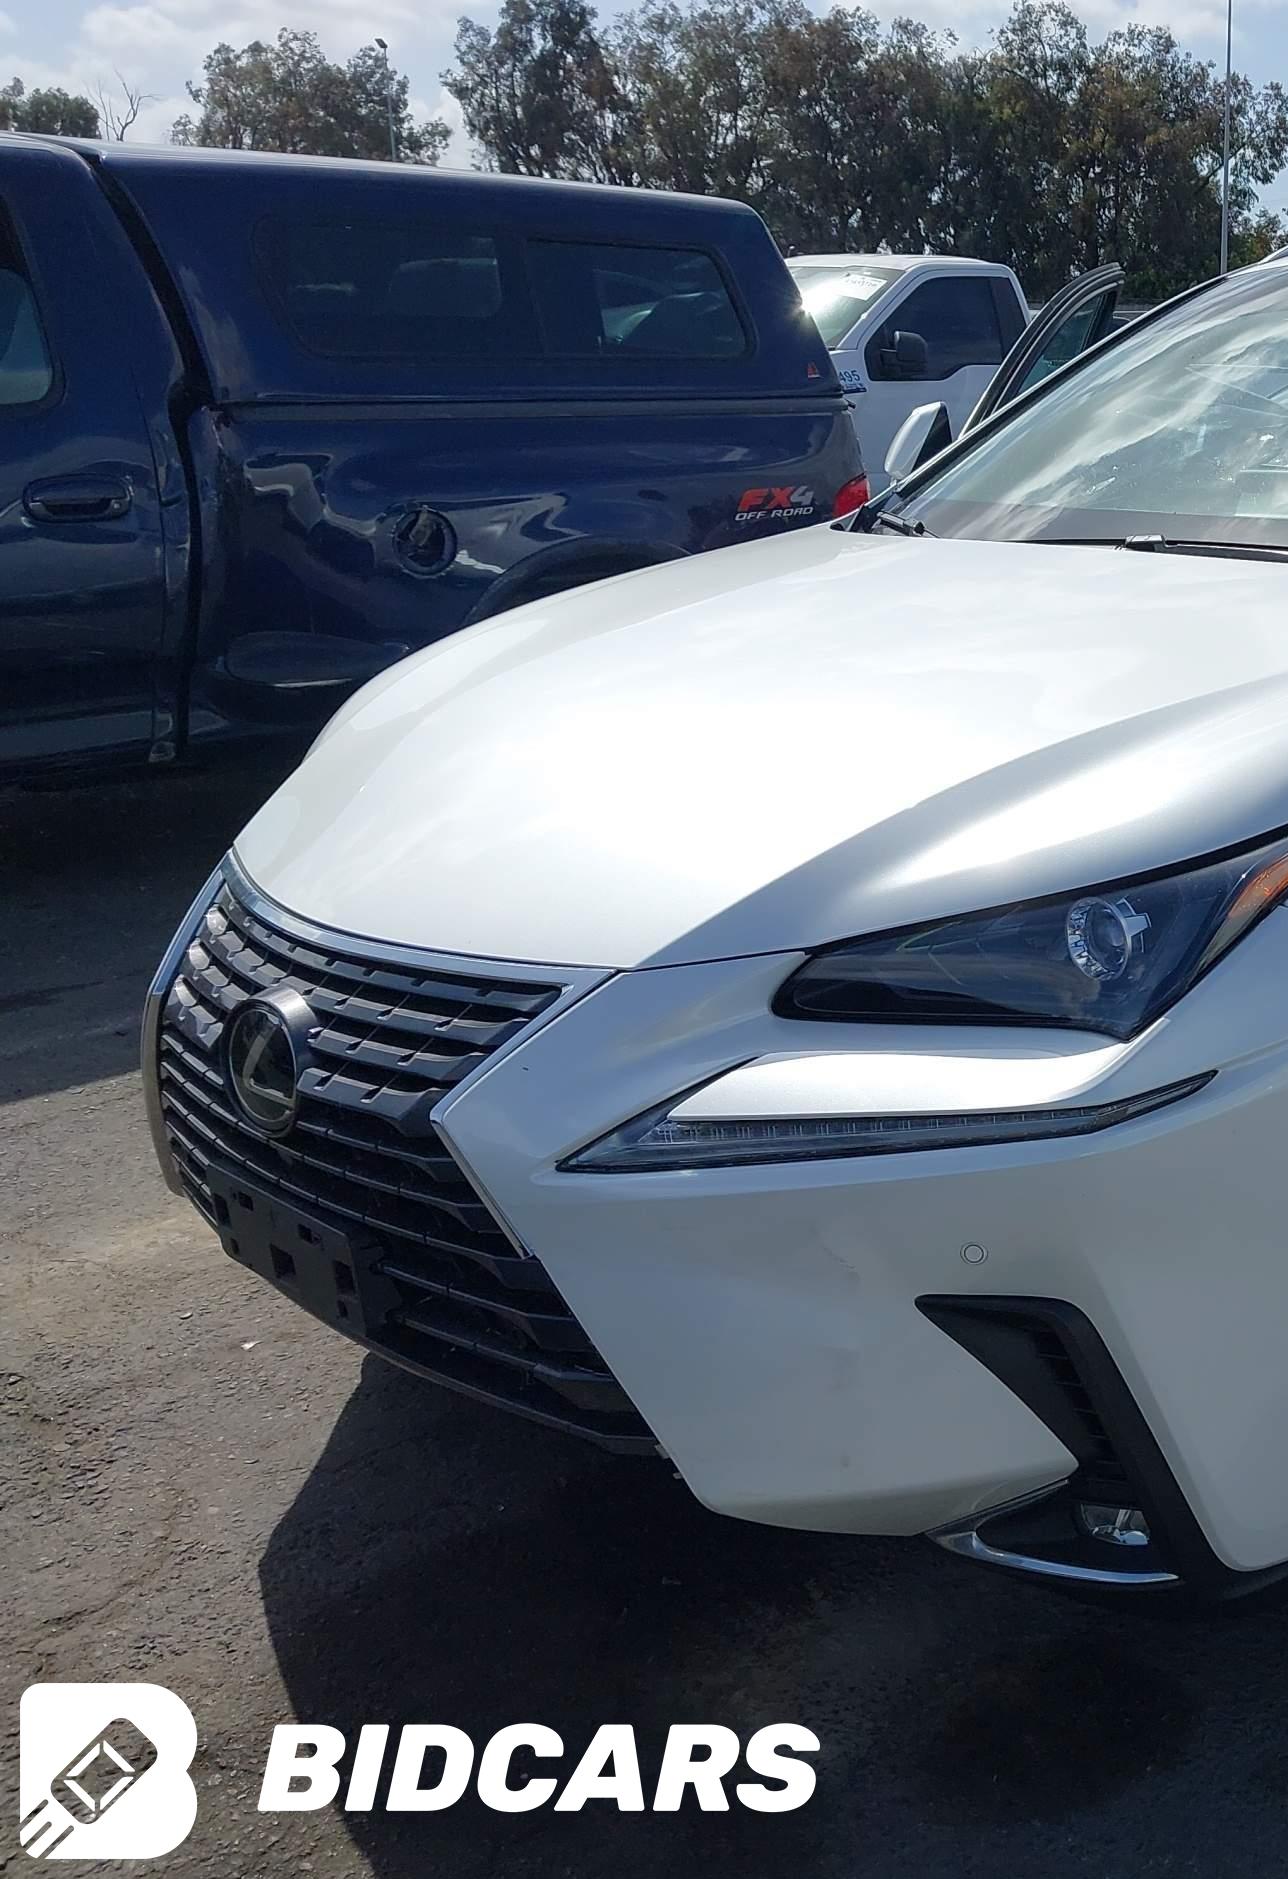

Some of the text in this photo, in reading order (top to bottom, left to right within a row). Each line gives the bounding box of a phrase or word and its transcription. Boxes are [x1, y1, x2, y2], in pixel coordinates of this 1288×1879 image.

[737, 486, 814, 512] FX4
[735, 506, 814, 521] OFF ROAD
